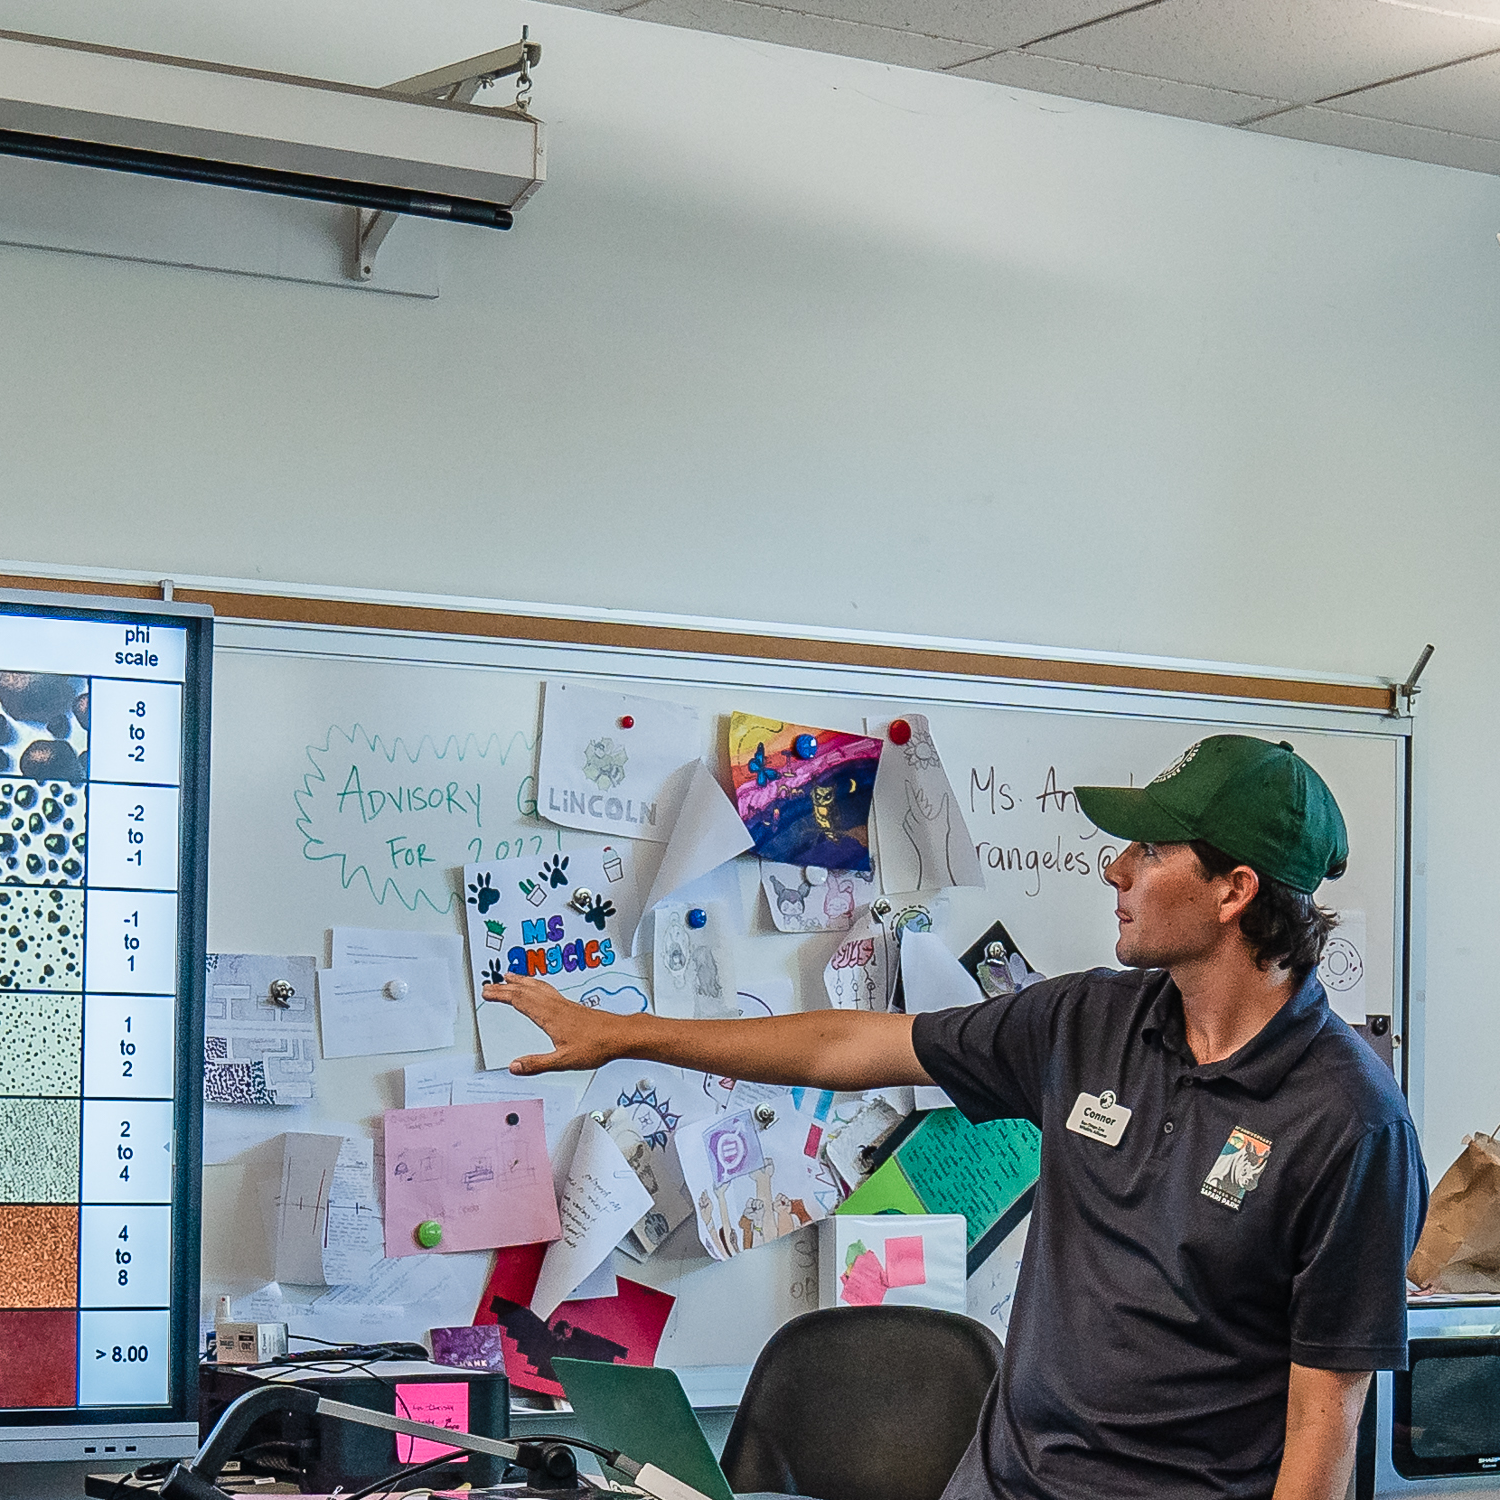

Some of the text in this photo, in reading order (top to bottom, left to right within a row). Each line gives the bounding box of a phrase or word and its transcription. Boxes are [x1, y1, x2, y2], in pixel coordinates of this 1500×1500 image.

[125, 626, 150, 645] phi
[115, 650, 158, 666] scale
[129, 701, 145, 717] -8
[129, 724, 145, 740] to
[128, 746, 144, 762] -2
[337, 765, 483, 827] ADVISORY
[971, 766, 1022, 814] Ms.
[128, 805, 144, 821] -2
[128, 828, 143, 844] to
[127, 850, 141, 866] -1
[386, 837, 435, 869] FOR
[124, 911, 137, 927] -1
[124, 934, 139, 950] to
[128, 955, 134, 971] 1
[125, 1017, 131, 1032] 1
[120, 1040, 135, 1055] to
[123, 1061, 132, 1077] 2
[1084, 1107, 1116, 1126] Connor
[121, 1121, 130, 1137] 2
[118, 1144, 133, 1159] to
[120, 1165, 129, 1181] 4
[119, 1225, 128, 1241] 4
[116, 1249, 131, 1264] to
[118, 1270, 128, 1286] 8
[112, 1346, 148, 1362] 8.00
